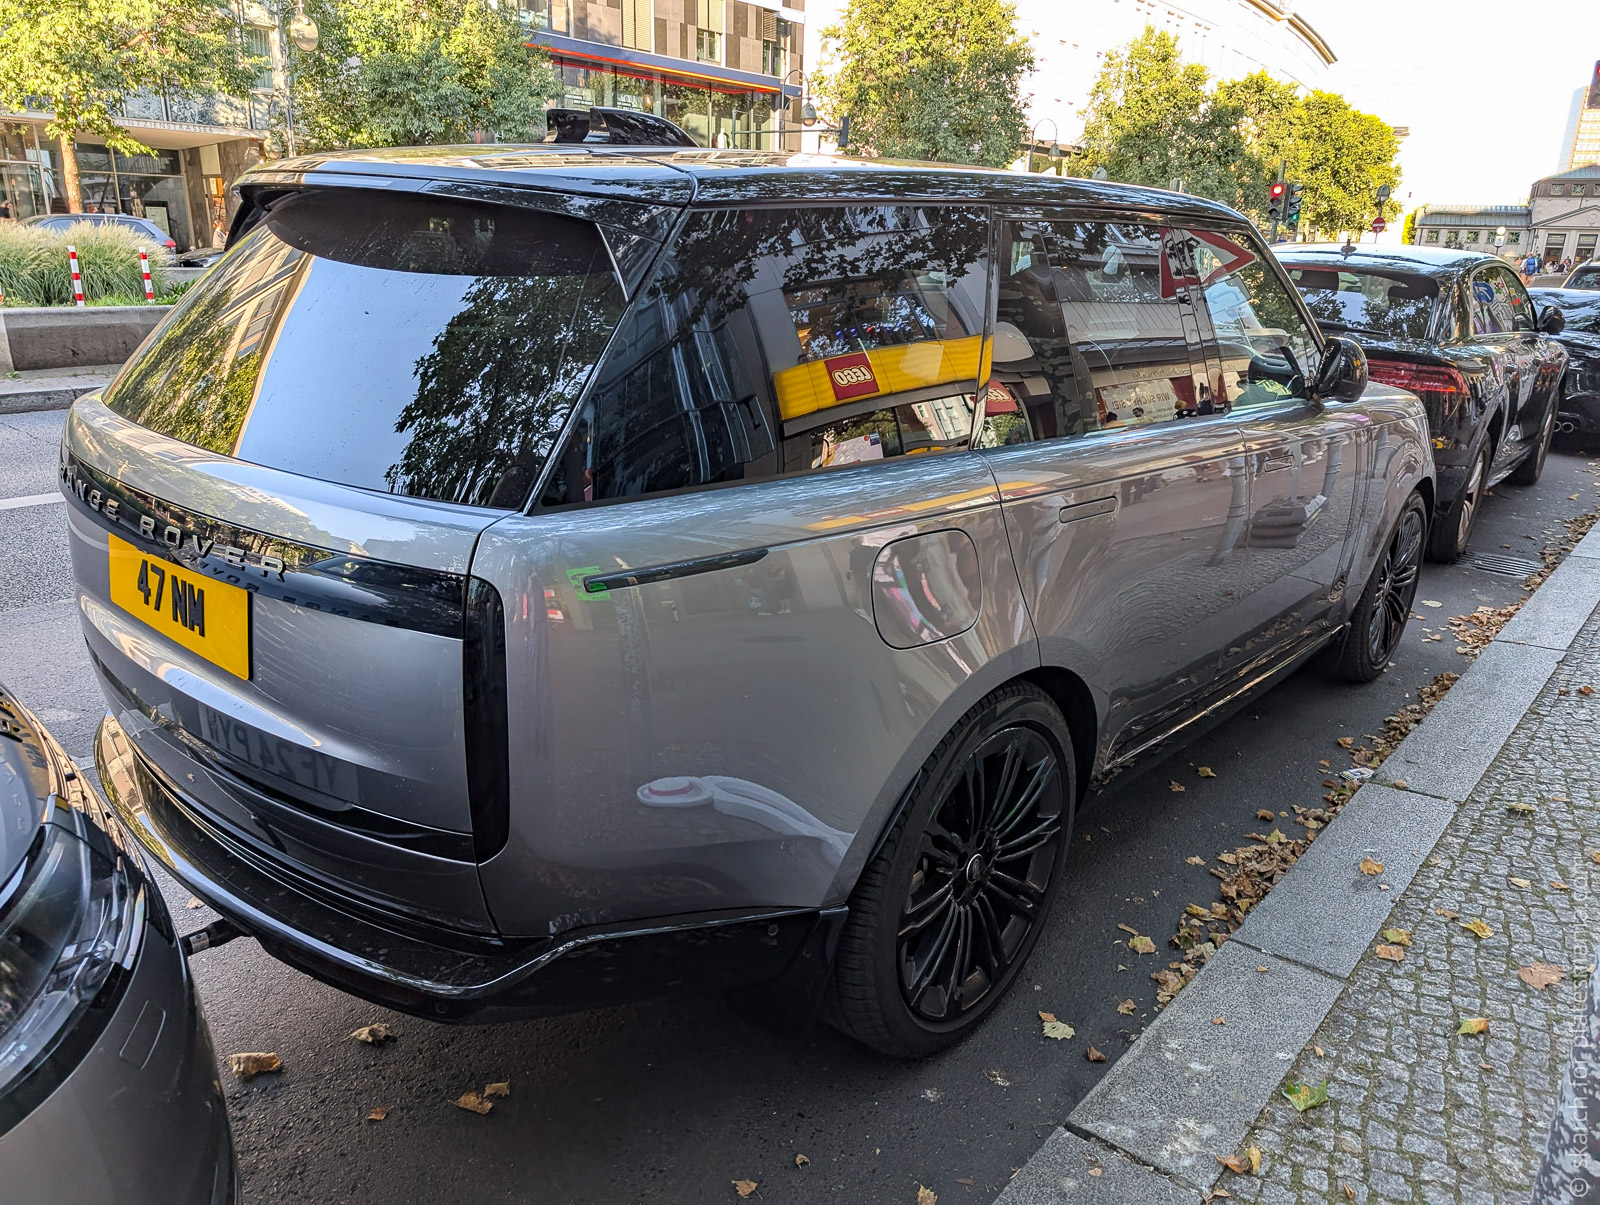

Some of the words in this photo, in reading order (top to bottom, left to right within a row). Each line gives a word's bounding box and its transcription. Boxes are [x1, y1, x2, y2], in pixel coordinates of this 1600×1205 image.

[60, 461, 121, 522] RANGE
[139, 514, 287, 583] ROVER
[137, 558, 166, 613] 47
[170, 574, 206, 638] NM
